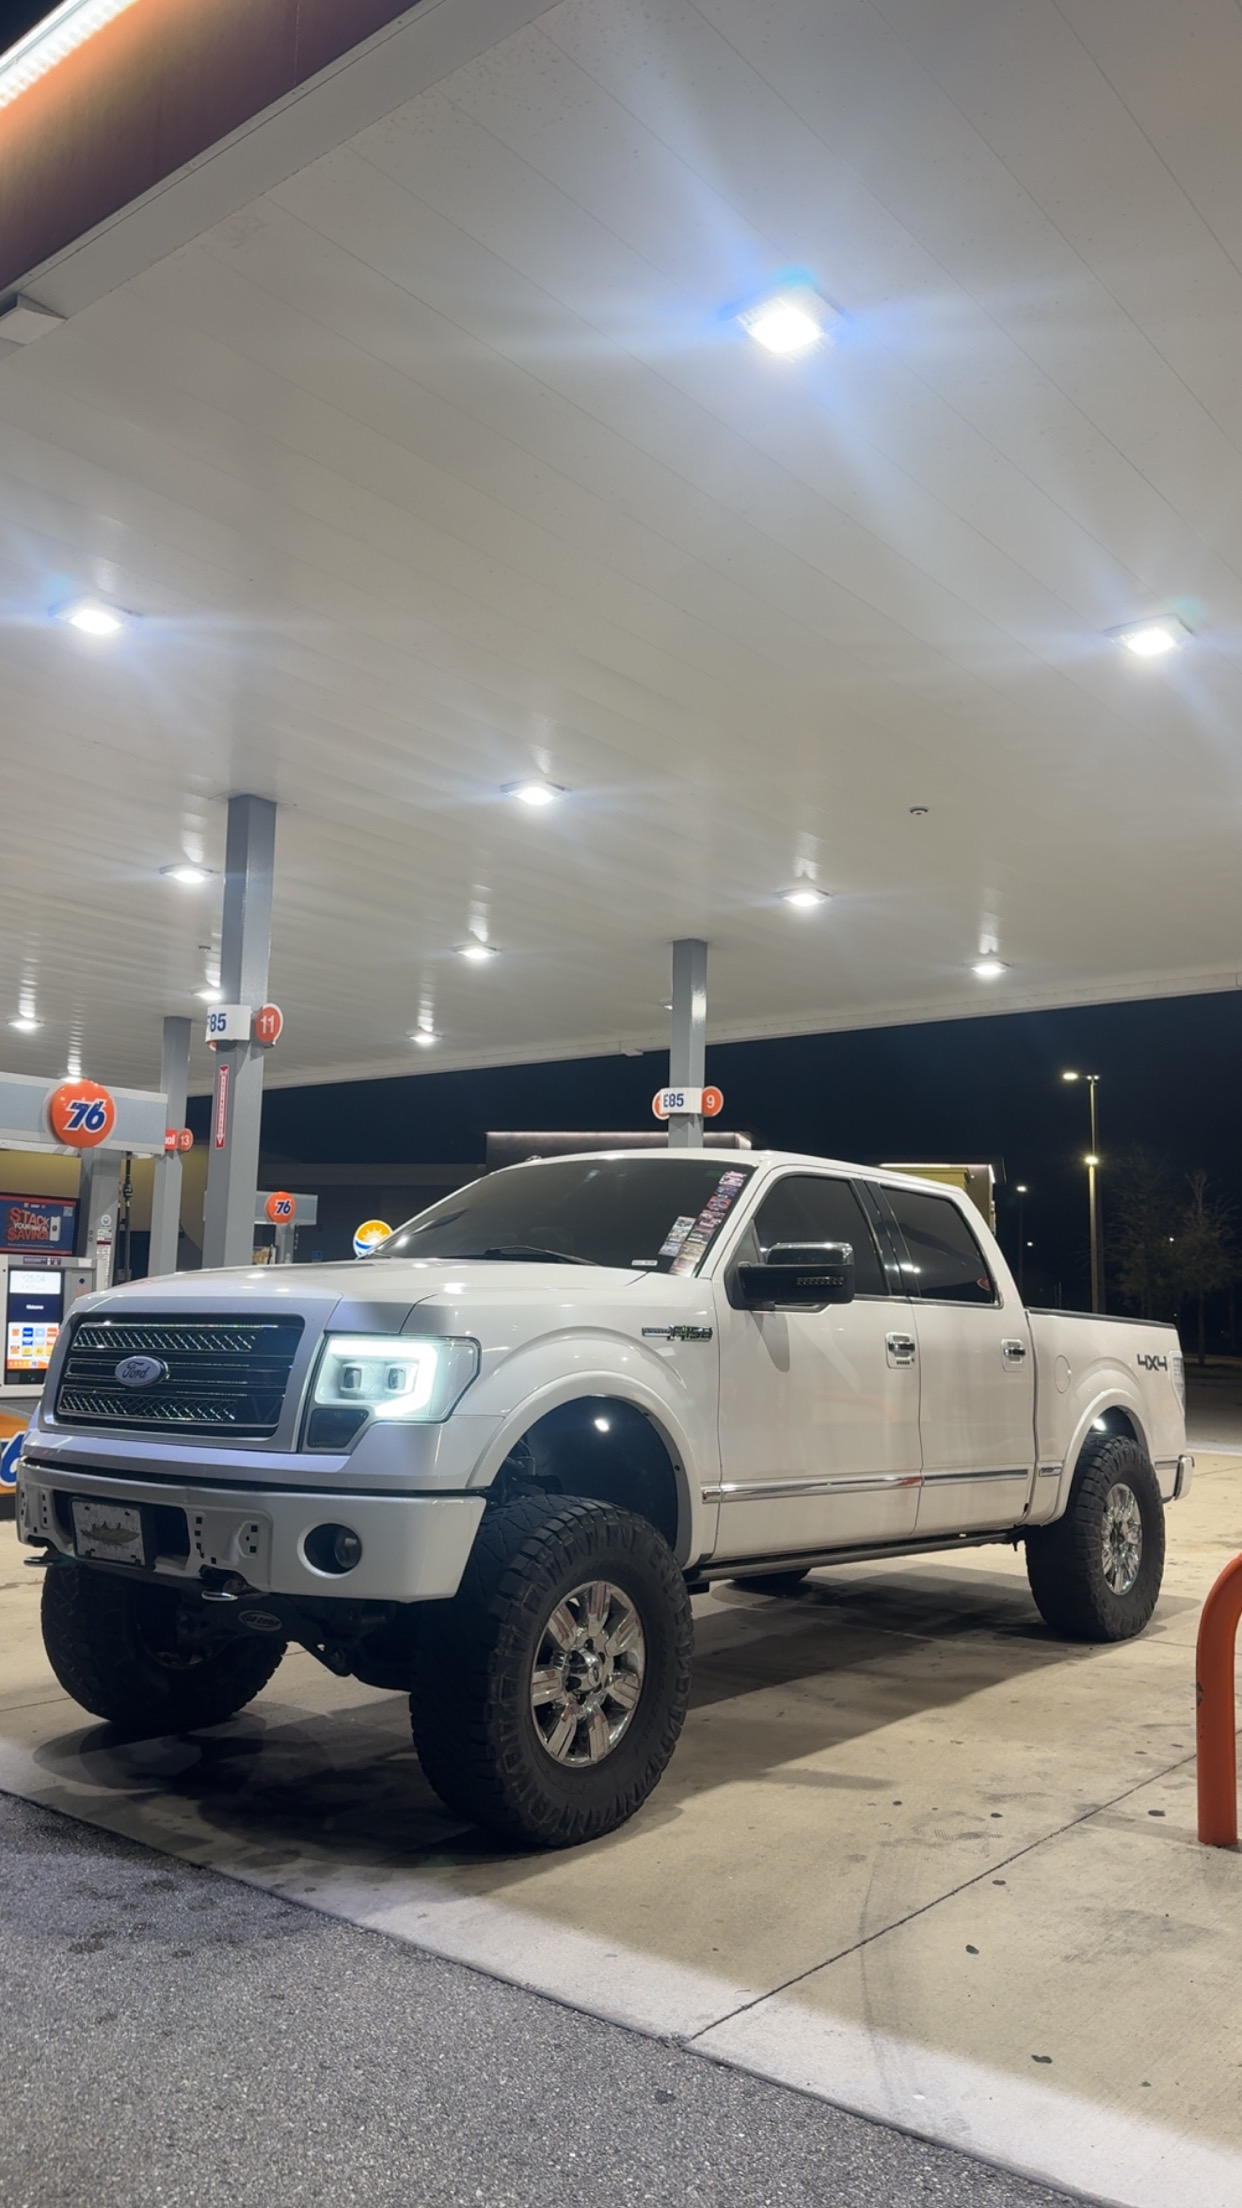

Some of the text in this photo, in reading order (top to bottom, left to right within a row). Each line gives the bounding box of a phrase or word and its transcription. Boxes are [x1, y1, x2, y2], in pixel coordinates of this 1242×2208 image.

[207, 1013, 227, 1032] 85
[260, 1015, 275, 1034] 11
[663, 1093, 685, 1108] E85
[706, 1094, 715, 1109] 9
[63, 1098, 107, 1133] 76
[181, 1135, 190, 1146] 13
[274, 1198, 292, 1215] 76
[9, 1206, 49, 1228] STACK
[122, 1361, 151, 1379] Ford
[0, 1431, 25, 1487] 6
